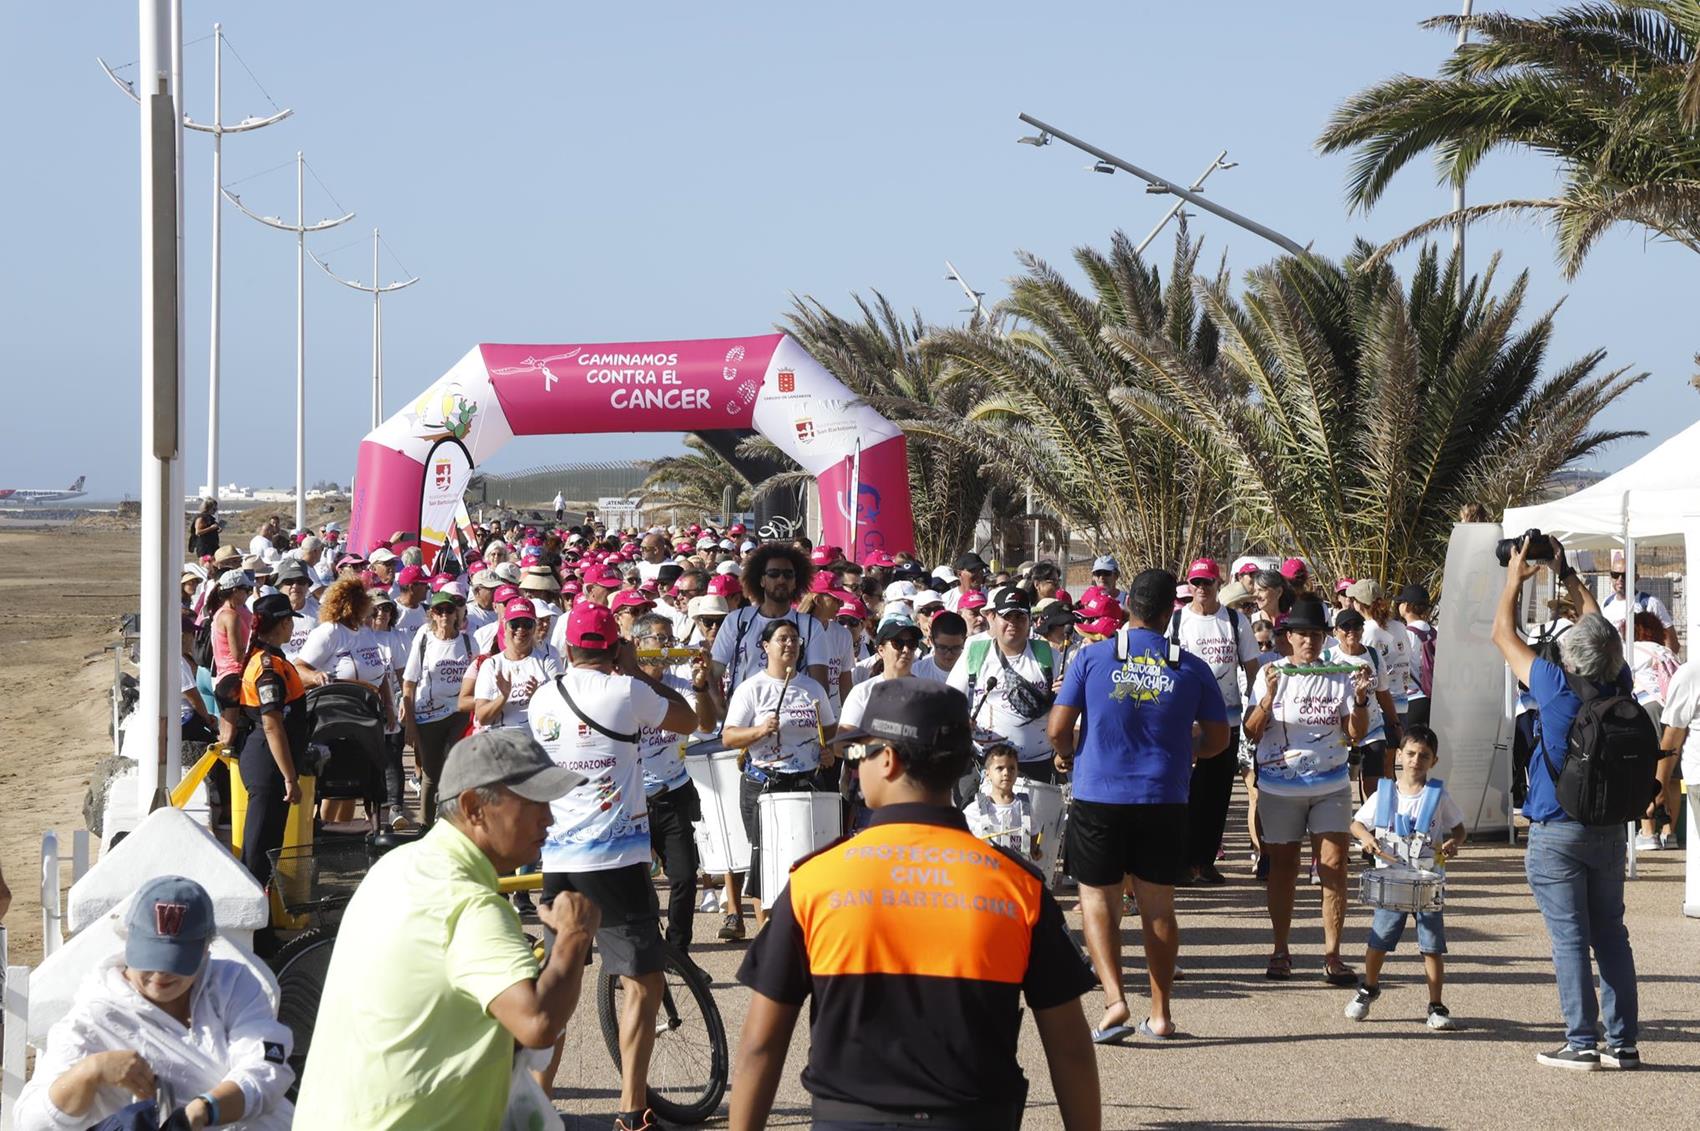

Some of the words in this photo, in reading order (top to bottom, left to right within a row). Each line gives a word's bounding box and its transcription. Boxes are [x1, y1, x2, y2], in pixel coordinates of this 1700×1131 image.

[577, 353, 678, 366] CAMINAMOS
[586, 369, 657, 384] CONTRA
[662, 369, 682, 384] EL
[610, 388, 712, 409] CANCER
[440, 667, 467, 676] CONT
[569, 757, 617, 771] CORAZONES
[844, 844, 1000, 870] PROTECCION
[891, 866, 955, 887] CIVIL
[828, 889, 875, 910] SAN
[154, 903, 190, 936] W
